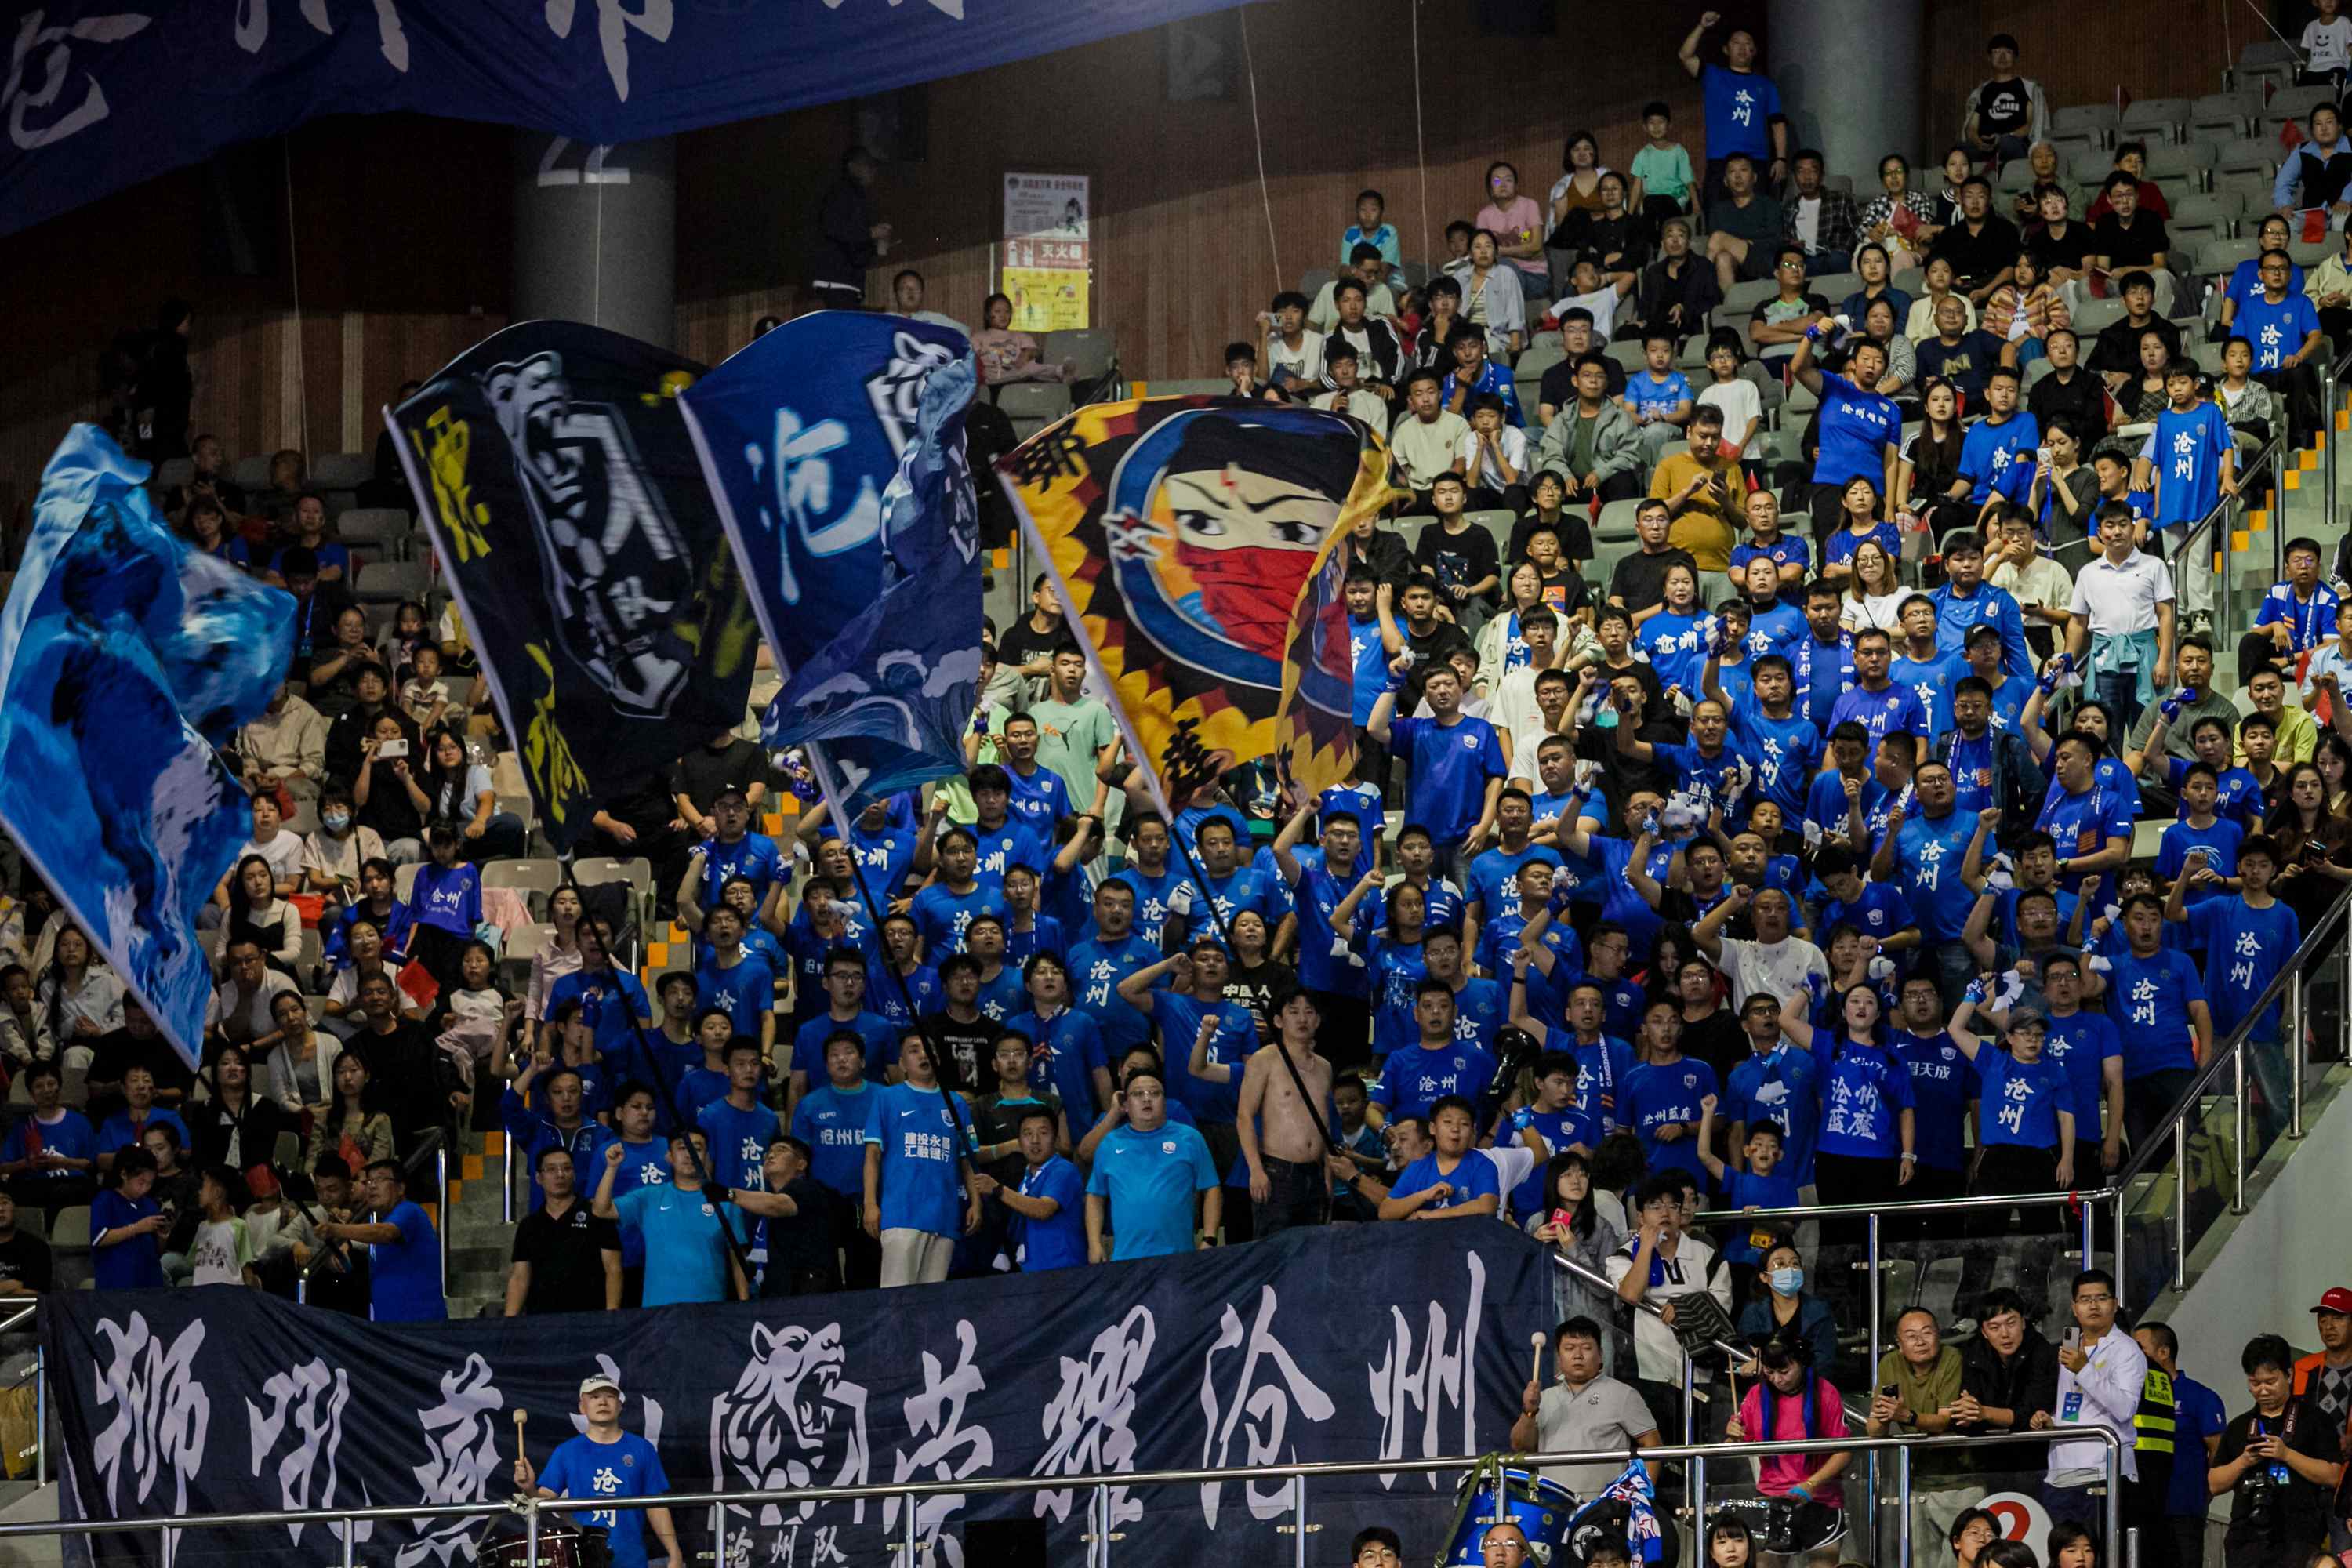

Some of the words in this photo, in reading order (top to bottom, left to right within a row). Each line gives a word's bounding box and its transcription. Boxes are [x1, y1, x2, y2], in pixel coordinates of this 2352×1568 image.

[1732, 89, 1755, 127] 沧州
[1041, 243, 1082, 260] 灭火器
[2259, 325, 2283, 369] 沧州
[2173, 431, 2197, 482] 沧州
[1916, 840, 1947, 891] 沧州
[1142, 898, 1167, 951] 沧州
[1086, 958, 1117, 1008] 沧州
[2230, 931, 2262, 990] 沧州
[1223, 982, 1272, 1000] 中国人
[2132, 977, 2161, 1027] 沧州
[1419, 1073, 1457, 1093] 沧州
[1831, 1076, 1879, 1112] 沧州
[1997, 1077, 2034, 1134] 沧州
[1826, 1104, 1878, 1142] 蓝魔
[640, 1161, 666, 1185] 沧
[741, 1137, 765, 1192] 沧州
[93, 1310, 665, 1568] 狮吼燕
